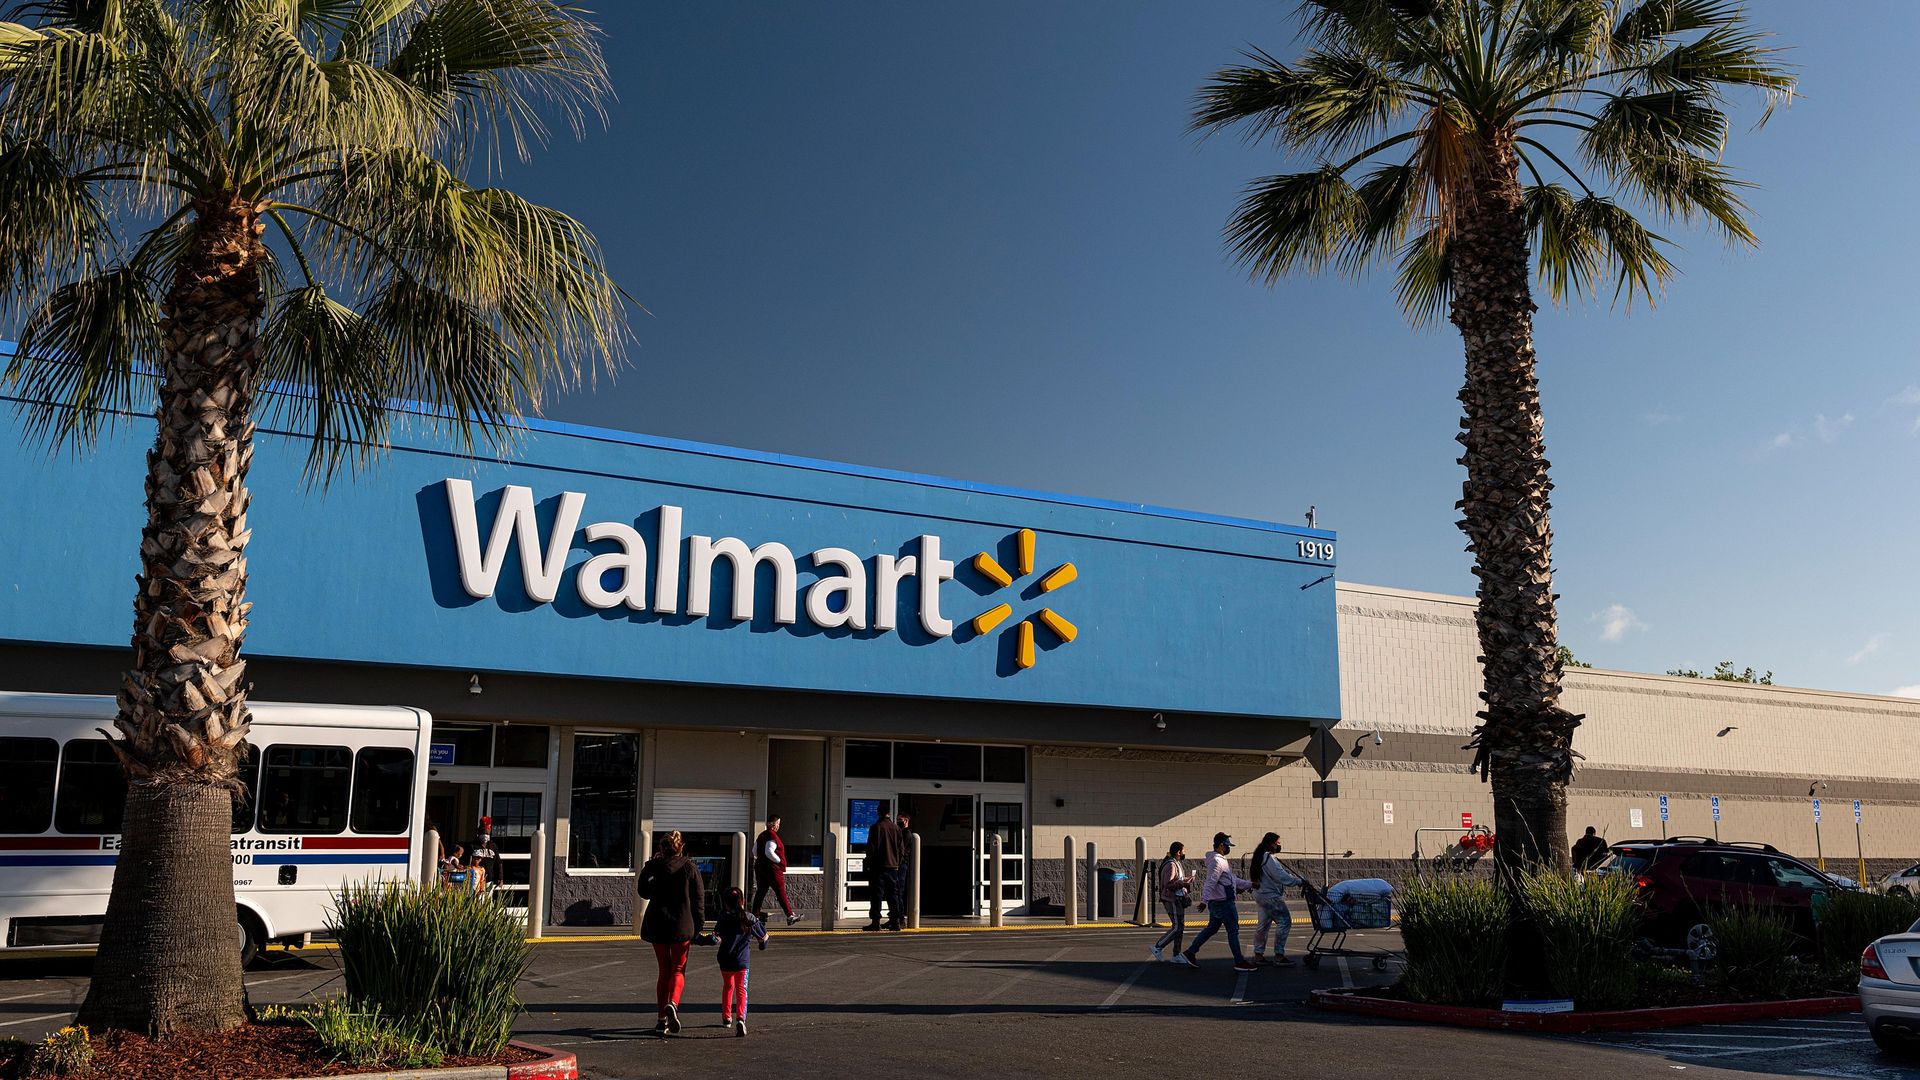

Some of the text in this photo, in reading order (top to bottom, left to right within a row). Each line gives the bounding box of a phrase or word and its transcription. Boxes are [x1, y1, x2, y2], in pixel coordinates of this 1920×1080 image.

[445, 477, 954, 638] Walmart
[1297, 540, 1334, 560] 1919
[102, 837, 300, 850] Ea atransit
[231, 854, 251, 865] 00
